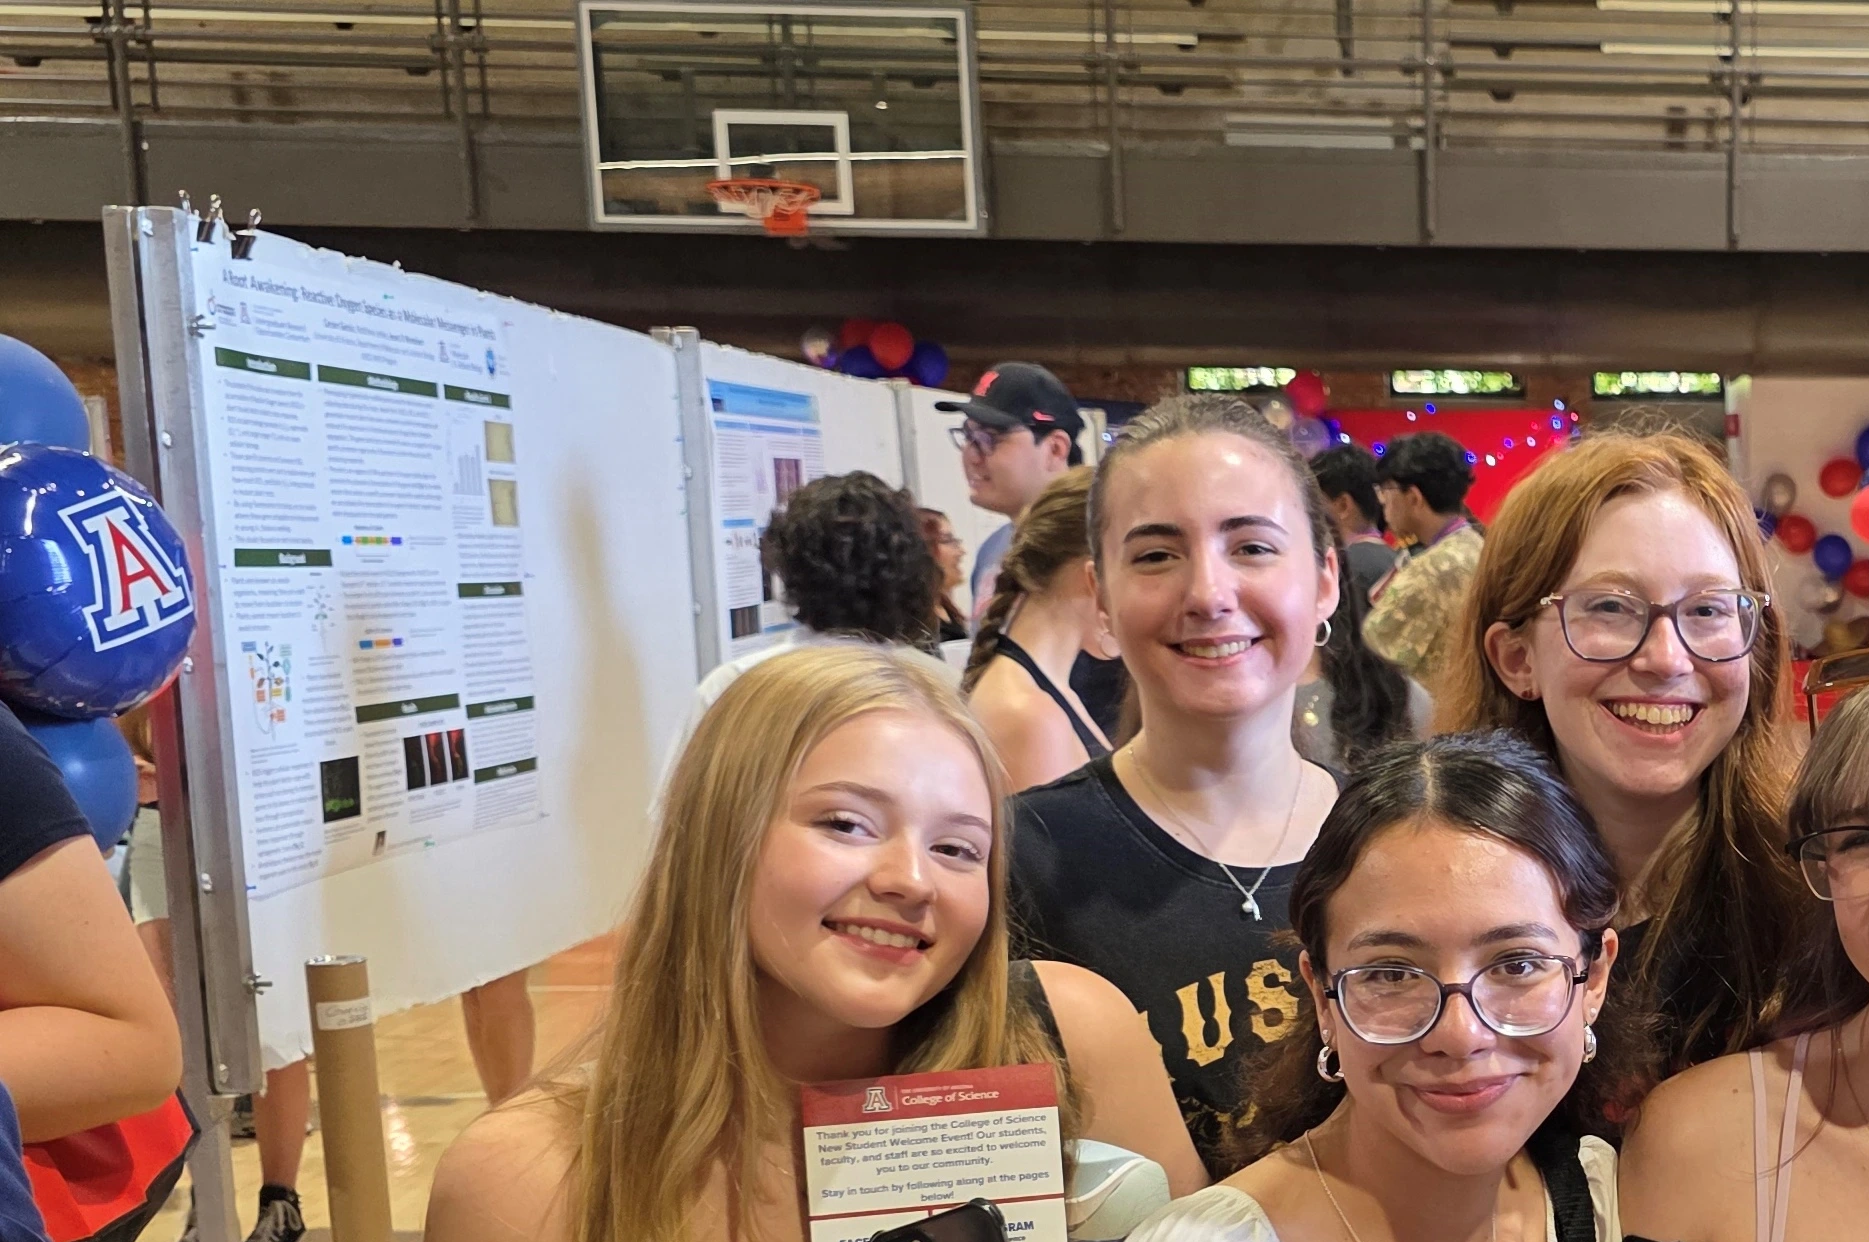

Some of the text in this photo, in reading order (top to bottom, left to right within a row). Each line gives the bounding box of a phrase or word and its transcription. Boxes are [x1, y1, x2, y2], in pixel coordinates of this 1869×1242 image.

[58, 489, 194, 652] A
[862, 1086, 893, 1114] A
[901, 1091, 1000, 1106] College of Science
[815, 1114, 1047, 1140] Thank you for joining the College of Science
[818, 1144, 843, 1153] New
[845, 1140, 887, 1151] Student
[889, 1136, 938, 1147] Welcome
[940, 1131, 974, 1143] Event!
[975, 1130, 996, 1140] Our
[861, 1152, 882, 1163] and
[884, 1150, 908, 1161] staff
[911, 1150, 929, 1158] are
[930, 1148, 944, 1156] so
[945, 1143, 984, 1155] excited
[986, 1143, 997, 1152] to
[999, 1140, 1046, 1150] welcome
[875, 1156, 993, 1176] you to our community.
[821, 1171, 1050, 1199] Stay in touch by following along at the pages
[920, 1191, 954, 1202] below!
